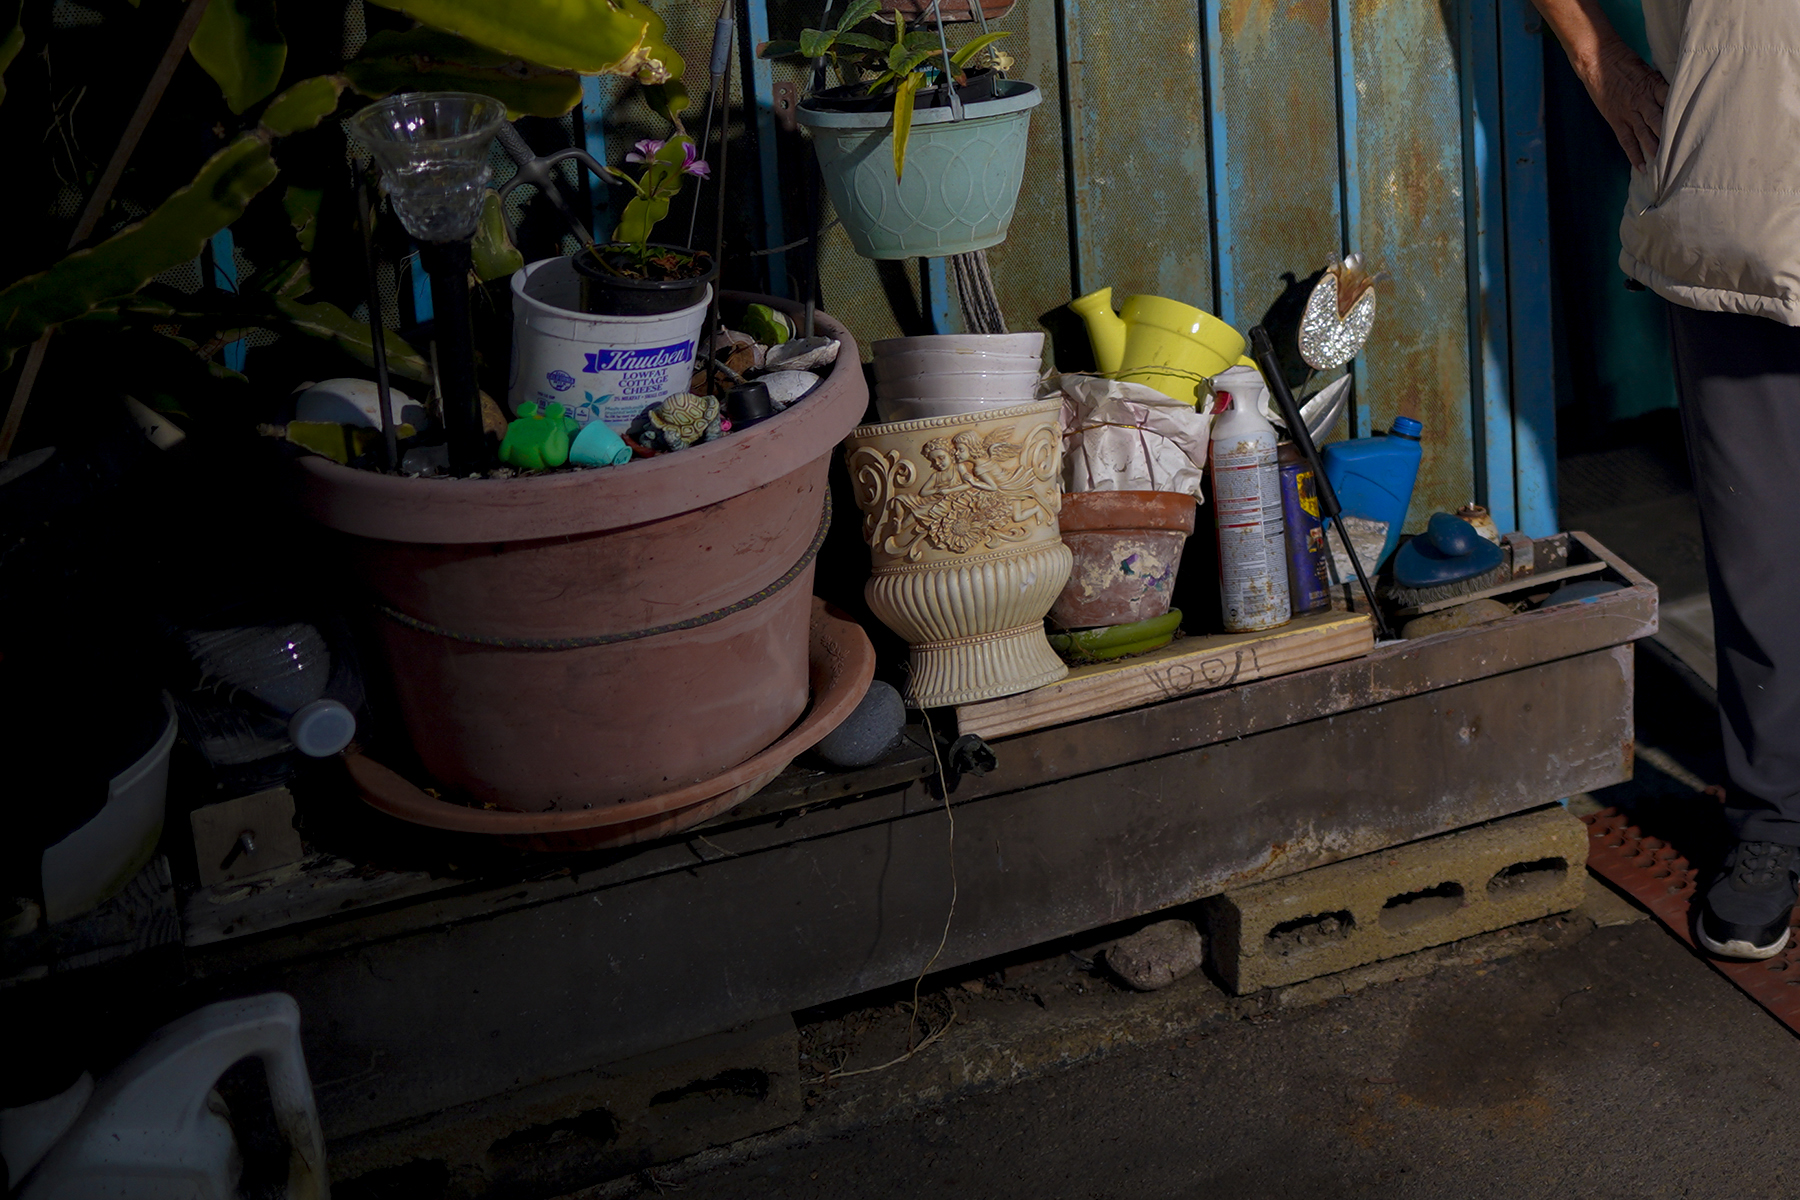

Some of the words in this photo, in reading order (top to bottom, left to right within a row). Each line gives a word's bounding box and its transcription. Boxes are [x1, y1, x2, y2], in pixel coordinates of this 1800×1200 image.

[601, 348, 685, 370] Knudsen
[623, 368, 668, 381] LOWFAT
[618, 375, 669, 388] COTTAGE
[622, 384, 663, 395] CHEESE
